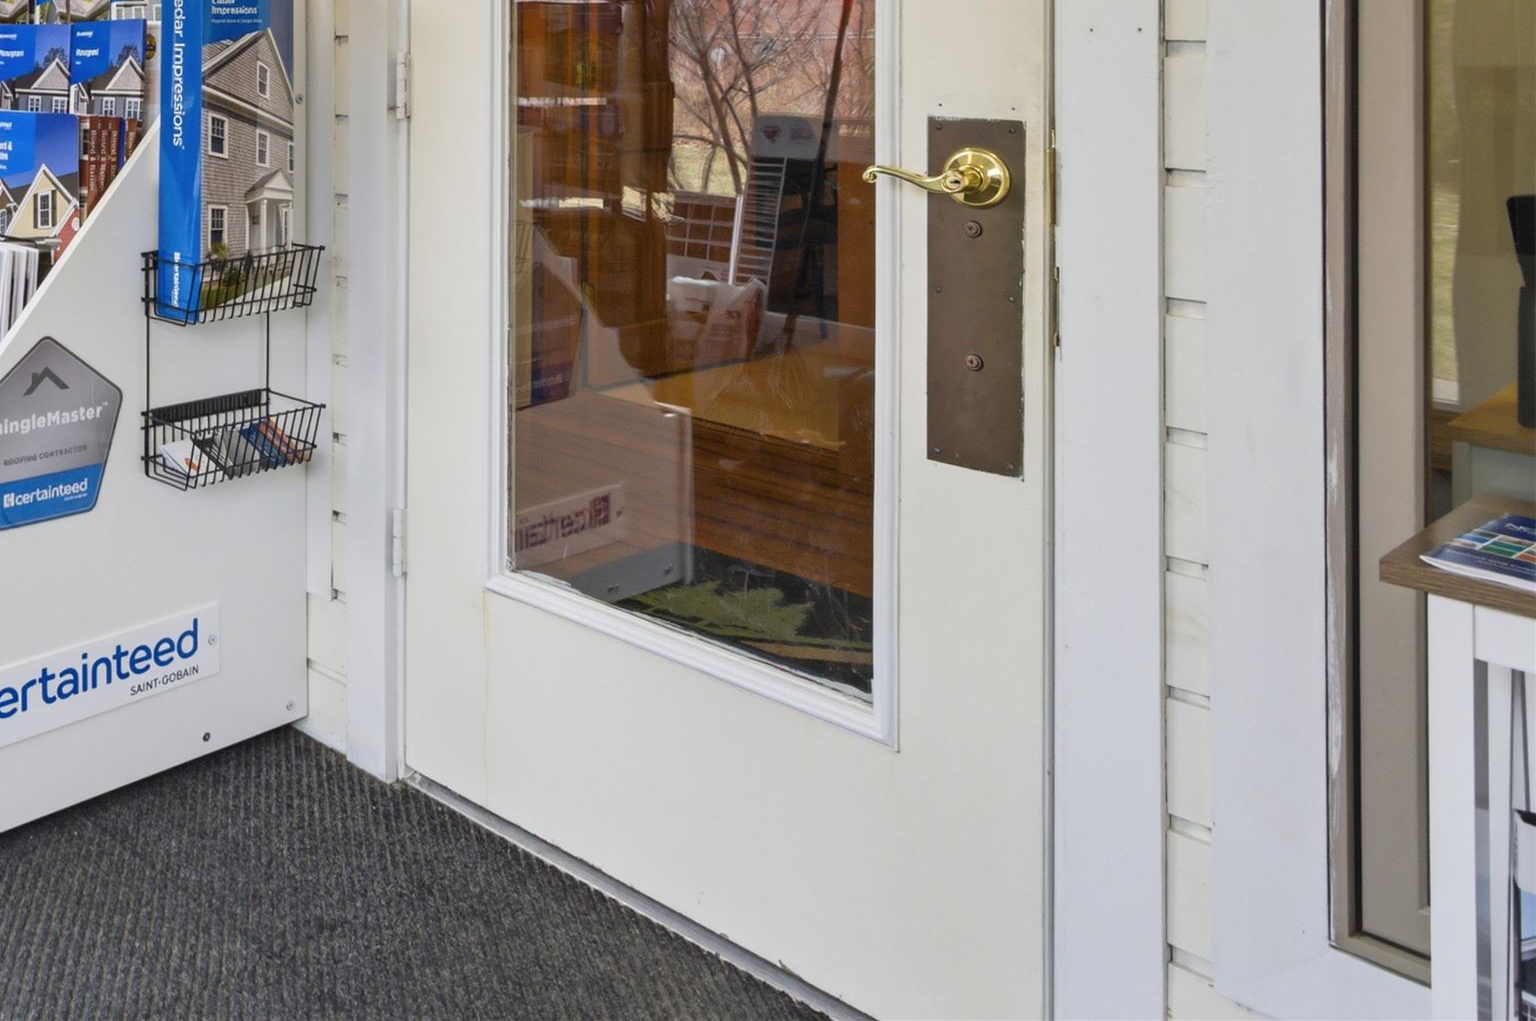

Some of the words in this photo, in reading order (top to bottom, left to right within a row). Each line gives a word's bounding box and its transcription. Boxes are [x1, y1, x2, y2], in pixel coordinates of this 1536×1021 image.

[211, 6, 258, 15] Impressions
[3, 454, 37, 467] ROOFING
[39, 445, 88, 460] CONTRACTOR
[15, 478, 88, 506] certainteed
[130, 664, 199, 697] SAINT-GOBAIN
